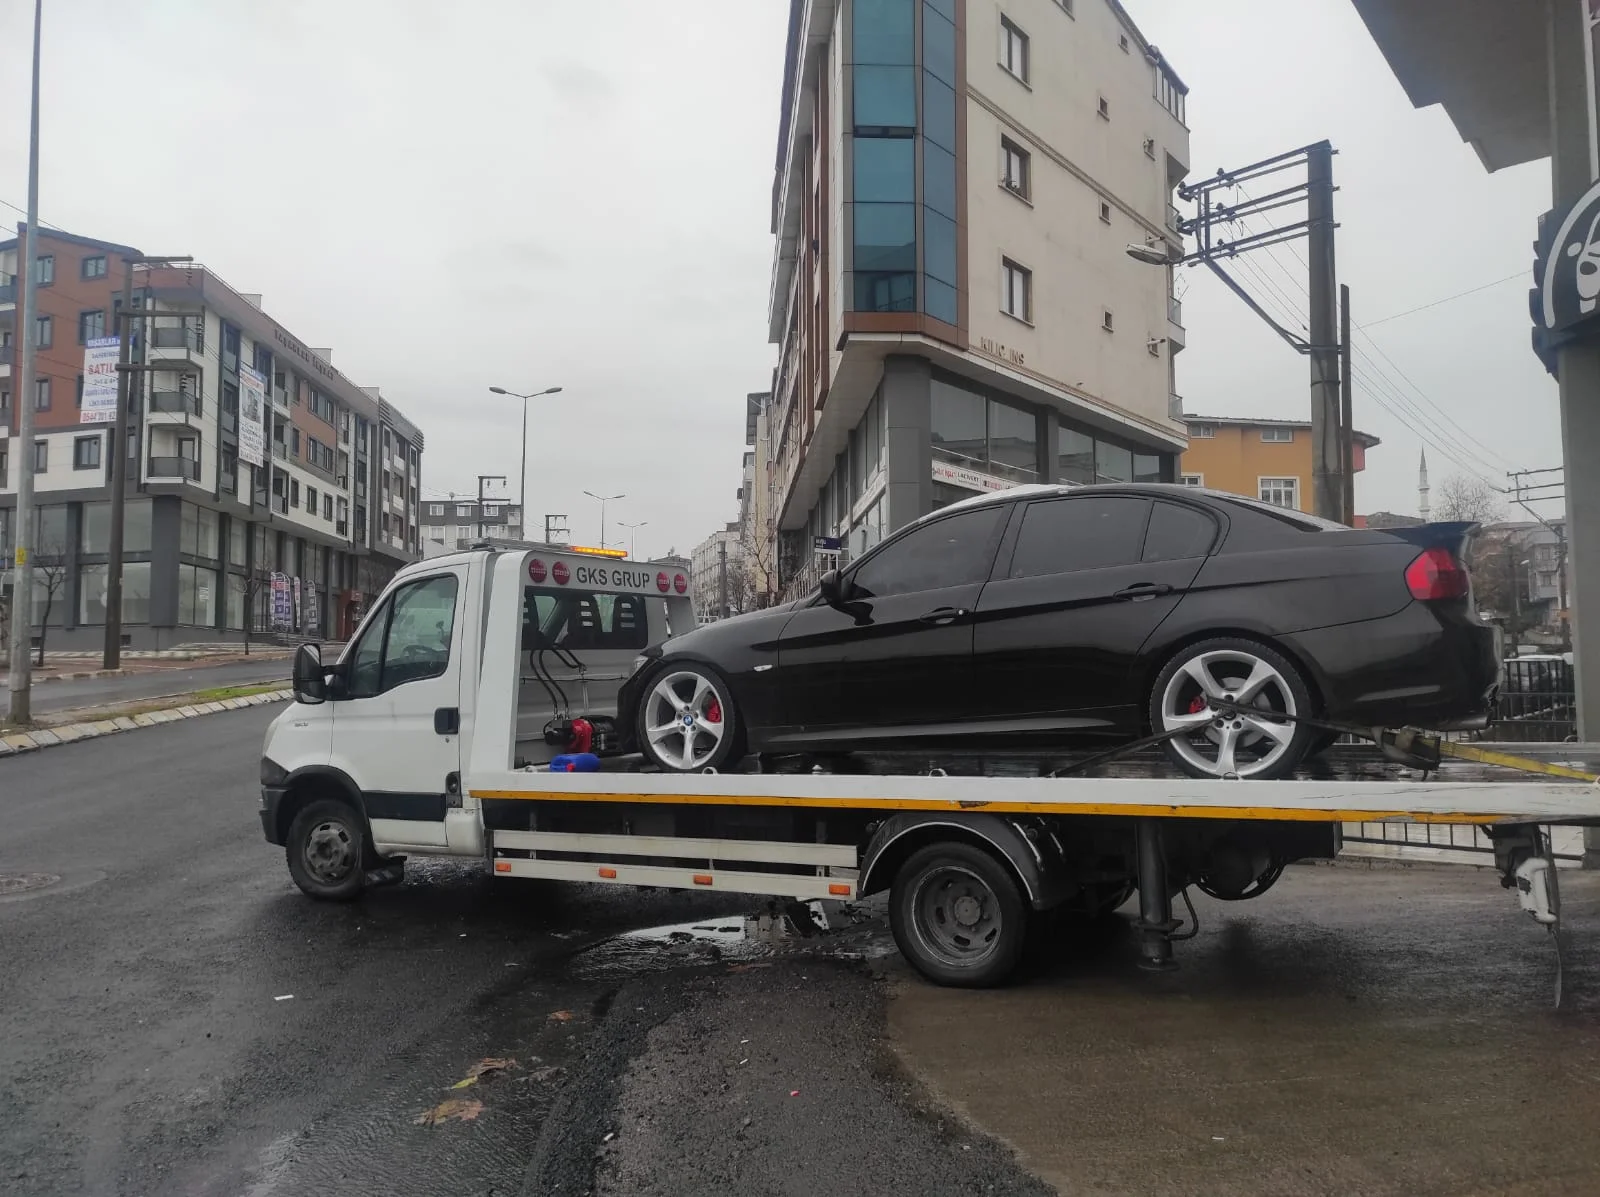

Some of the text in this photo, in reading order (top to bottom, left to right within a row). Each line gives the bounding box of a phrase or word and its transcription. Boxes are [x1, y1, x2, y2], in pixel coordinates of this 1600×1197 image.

[88, 362, 115, 375] SATIL
[576, 566, 650, 589] GKS GRUP
